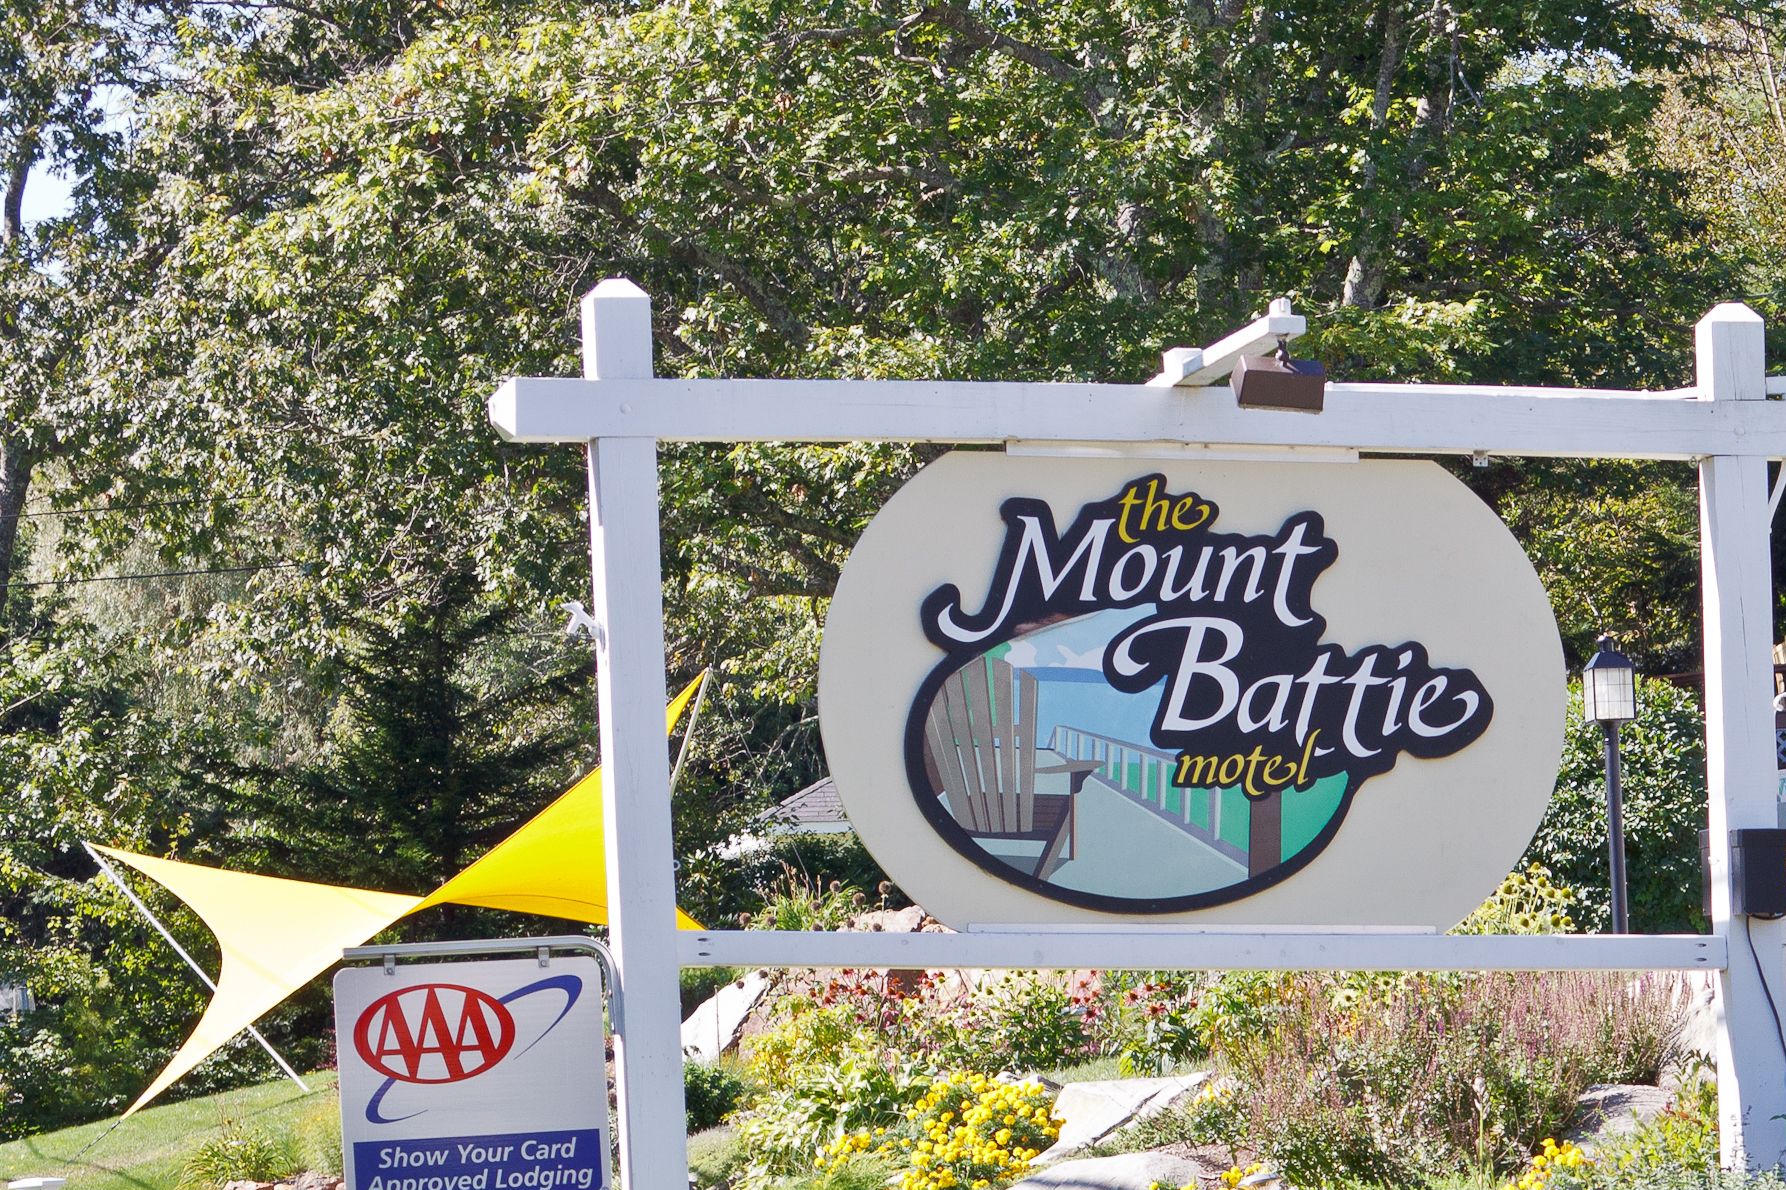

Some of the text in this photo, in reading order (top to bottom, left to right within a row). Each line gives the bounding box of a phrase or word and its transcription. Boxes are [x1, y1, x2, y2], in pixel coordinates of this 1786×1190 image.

[1118, 480, 1212, 544] the
[937, 515, 1322, 643] Mount
[1112, 617, 1480, 758] Battie
[1176, 728, 1320, 796] motel
[367, 986, 502, 1082] AAA
[378, 1137, 577, 1169] Show Your Card
[495, 1165, 593, 1190] Lodging
